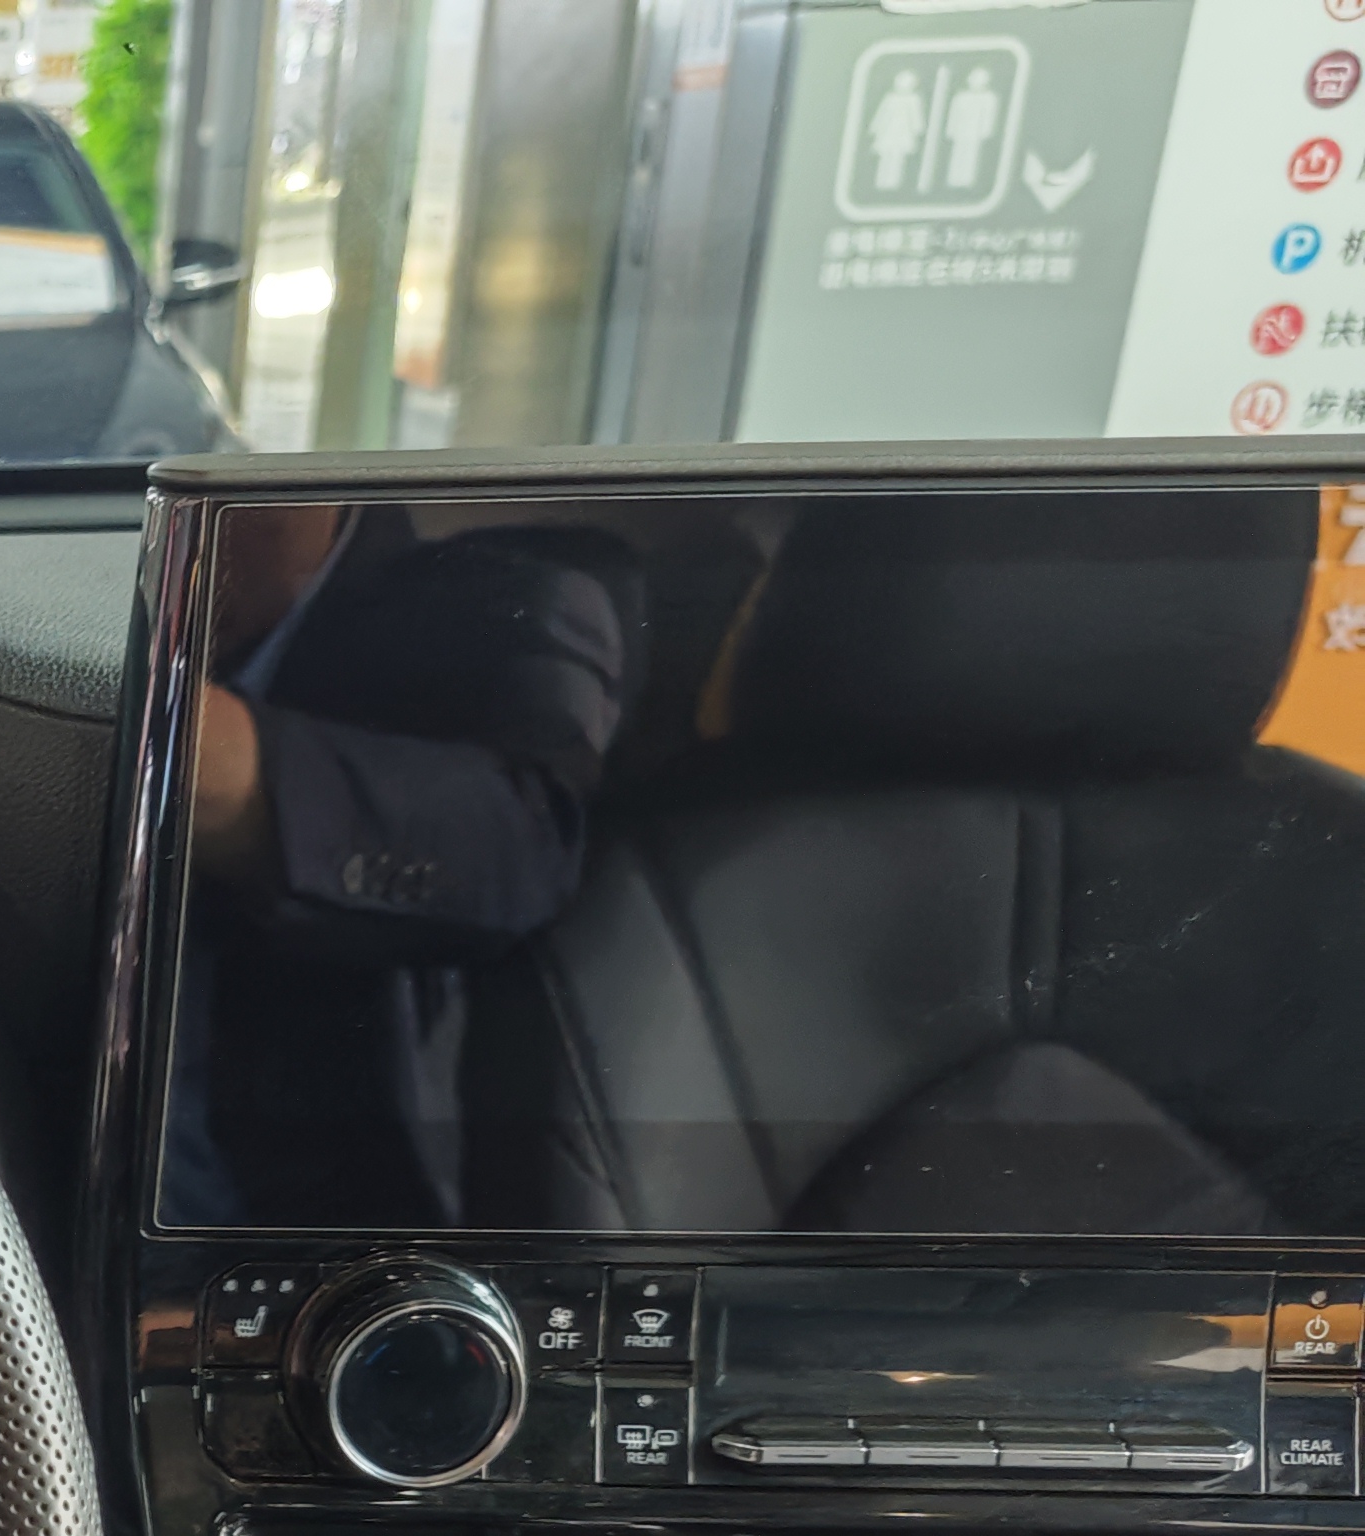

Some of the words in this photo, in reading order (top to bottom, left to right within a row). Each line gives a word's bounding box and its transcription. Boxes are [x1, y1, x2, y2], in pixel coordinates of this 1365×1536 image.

[539, 1332, 584, 1350] OFF
[624, 1335, 674, 1348] FRONT
[1294, 1341, 1336, 1355] REAR
[1290, 1439, 1332, 1453] REAR
[626, 1452, 668, 1465] REAR
[1279, 1452, 1344, 1467] CLIMATE
